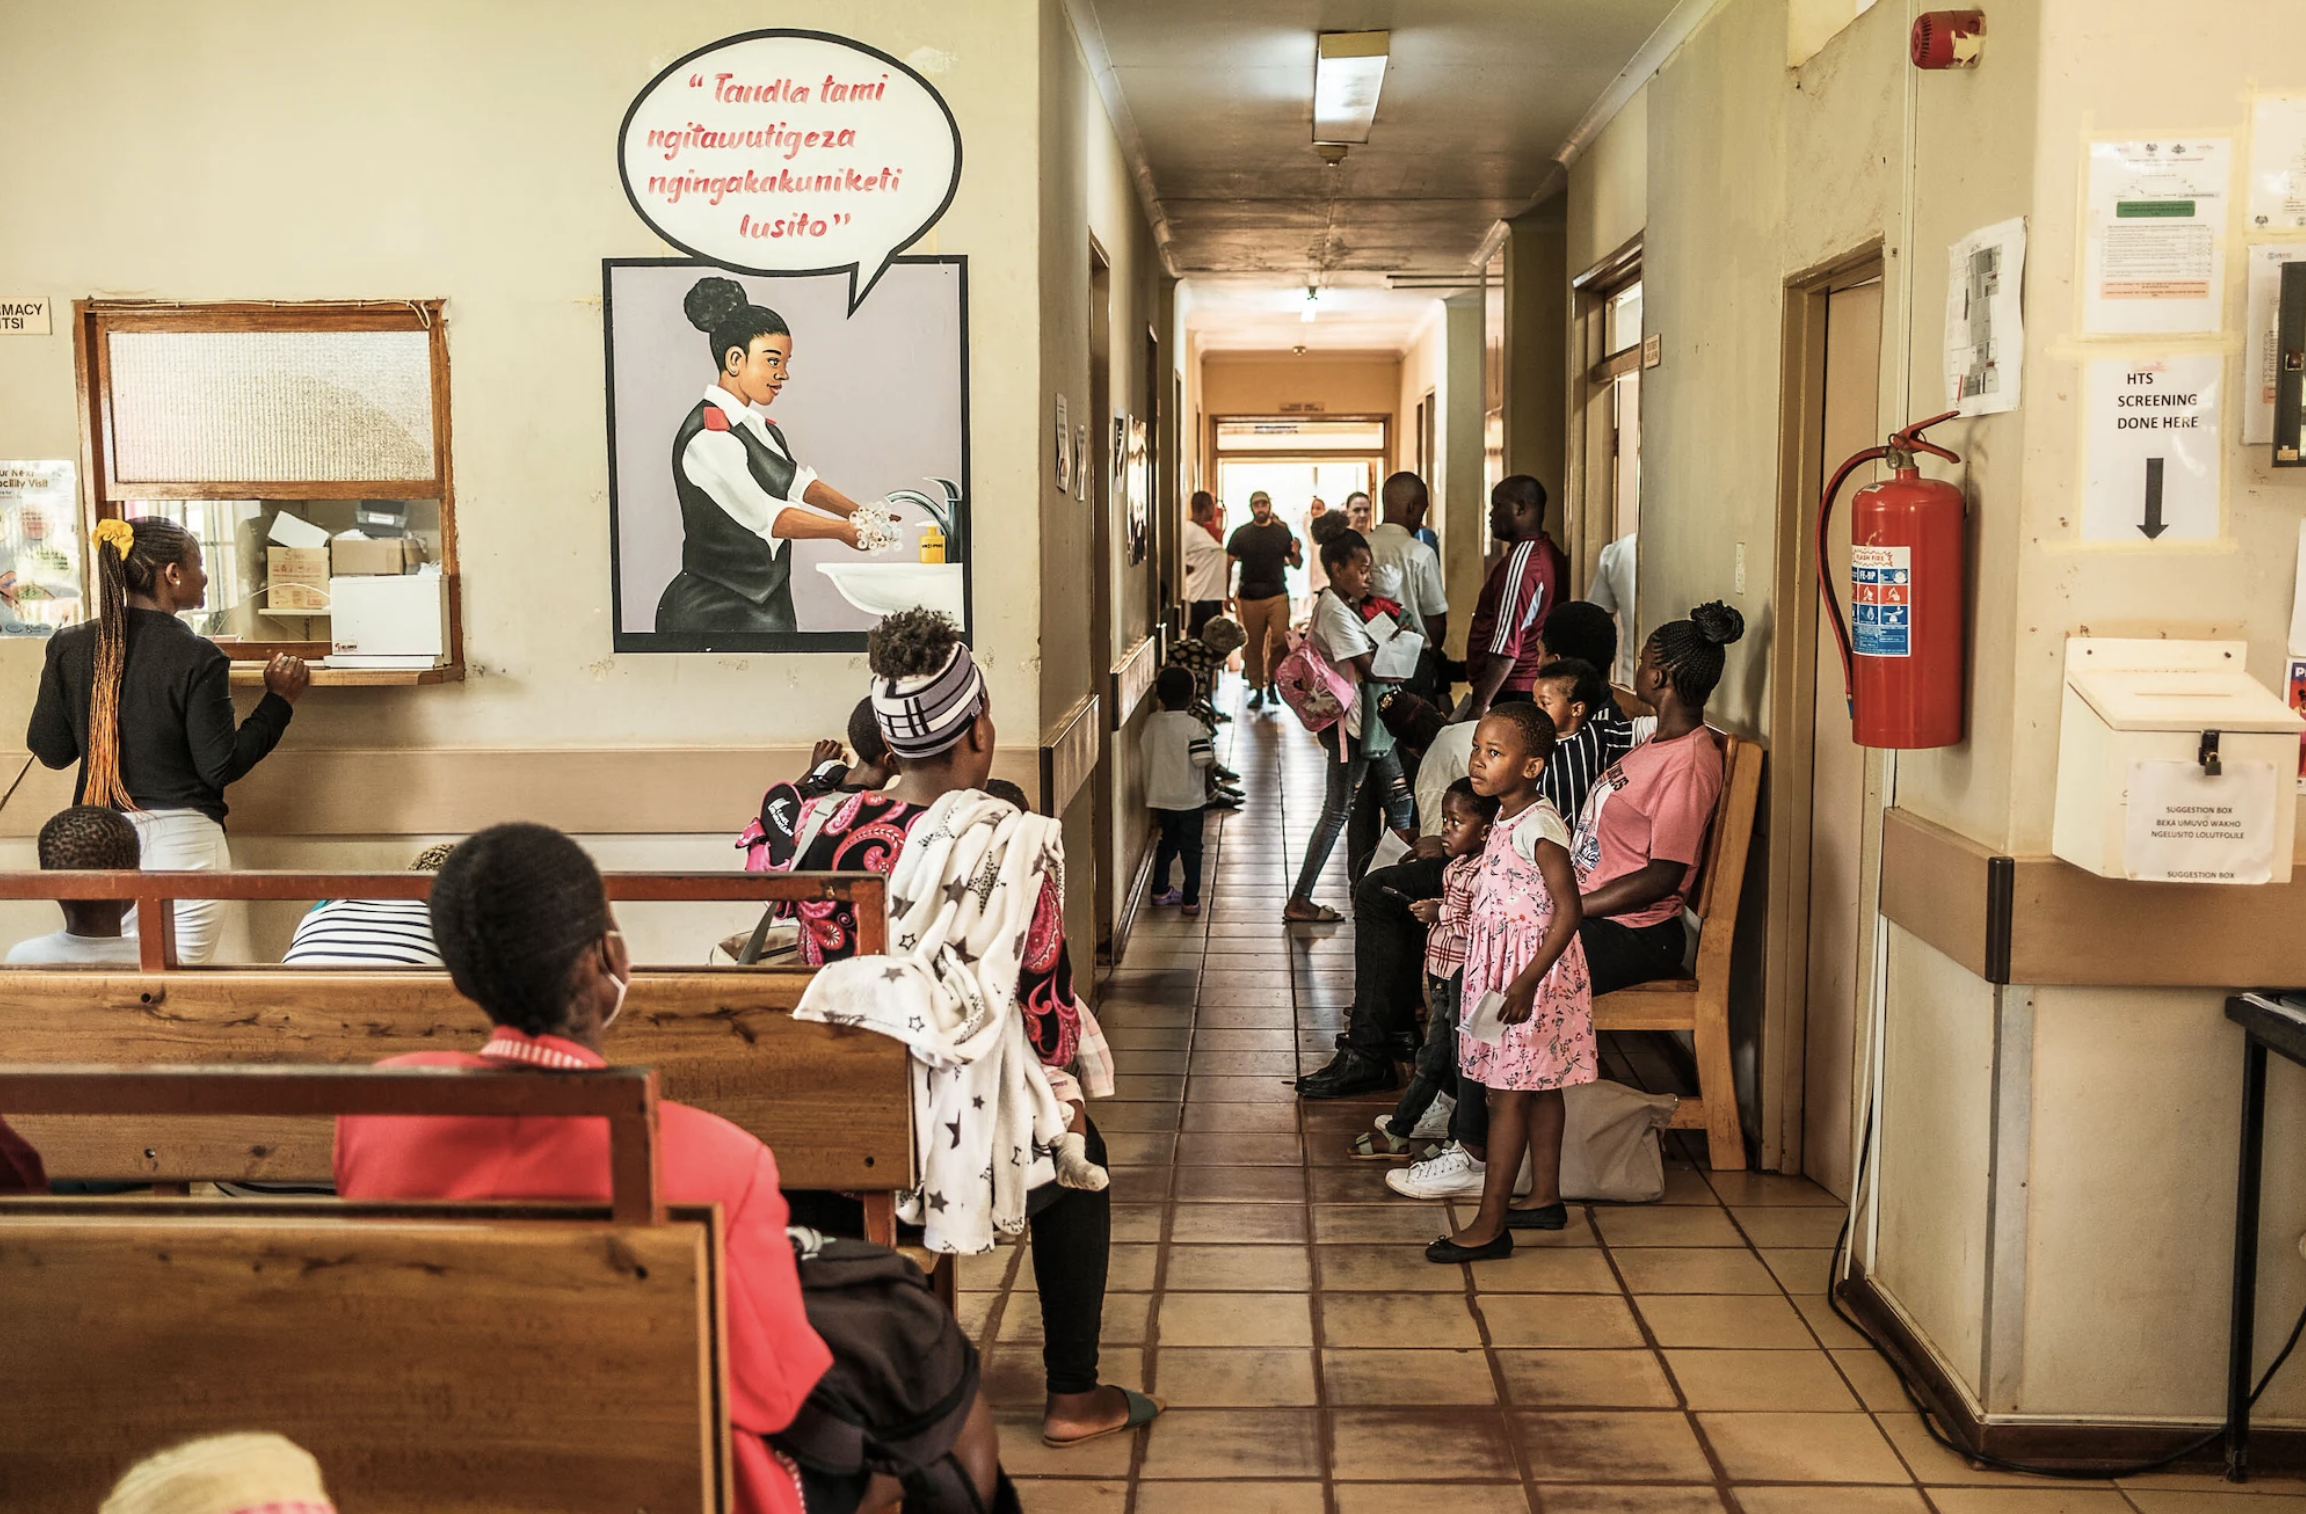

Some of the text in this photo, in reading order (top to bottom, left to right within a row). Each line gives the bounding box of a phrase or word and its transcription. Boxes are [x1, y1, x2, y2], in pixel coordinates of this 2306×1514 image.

[820, 74, 889, 103] tami
[647, 121, 857, 161] ngitawutigeza
[648, 167, 904, 206] ngingakakuniketi
[0, 303, 42, 316] MACY
[2126, 372, 2154, 385] HTS
[2117, 393, 2198, 408] SCREENING
[2117, 415, 2199, 430] DONE HERE
[2166, 806, 2215, 814] SUGGESTION
[2167, 871, 2235, 879] SUGGESTION BOX
